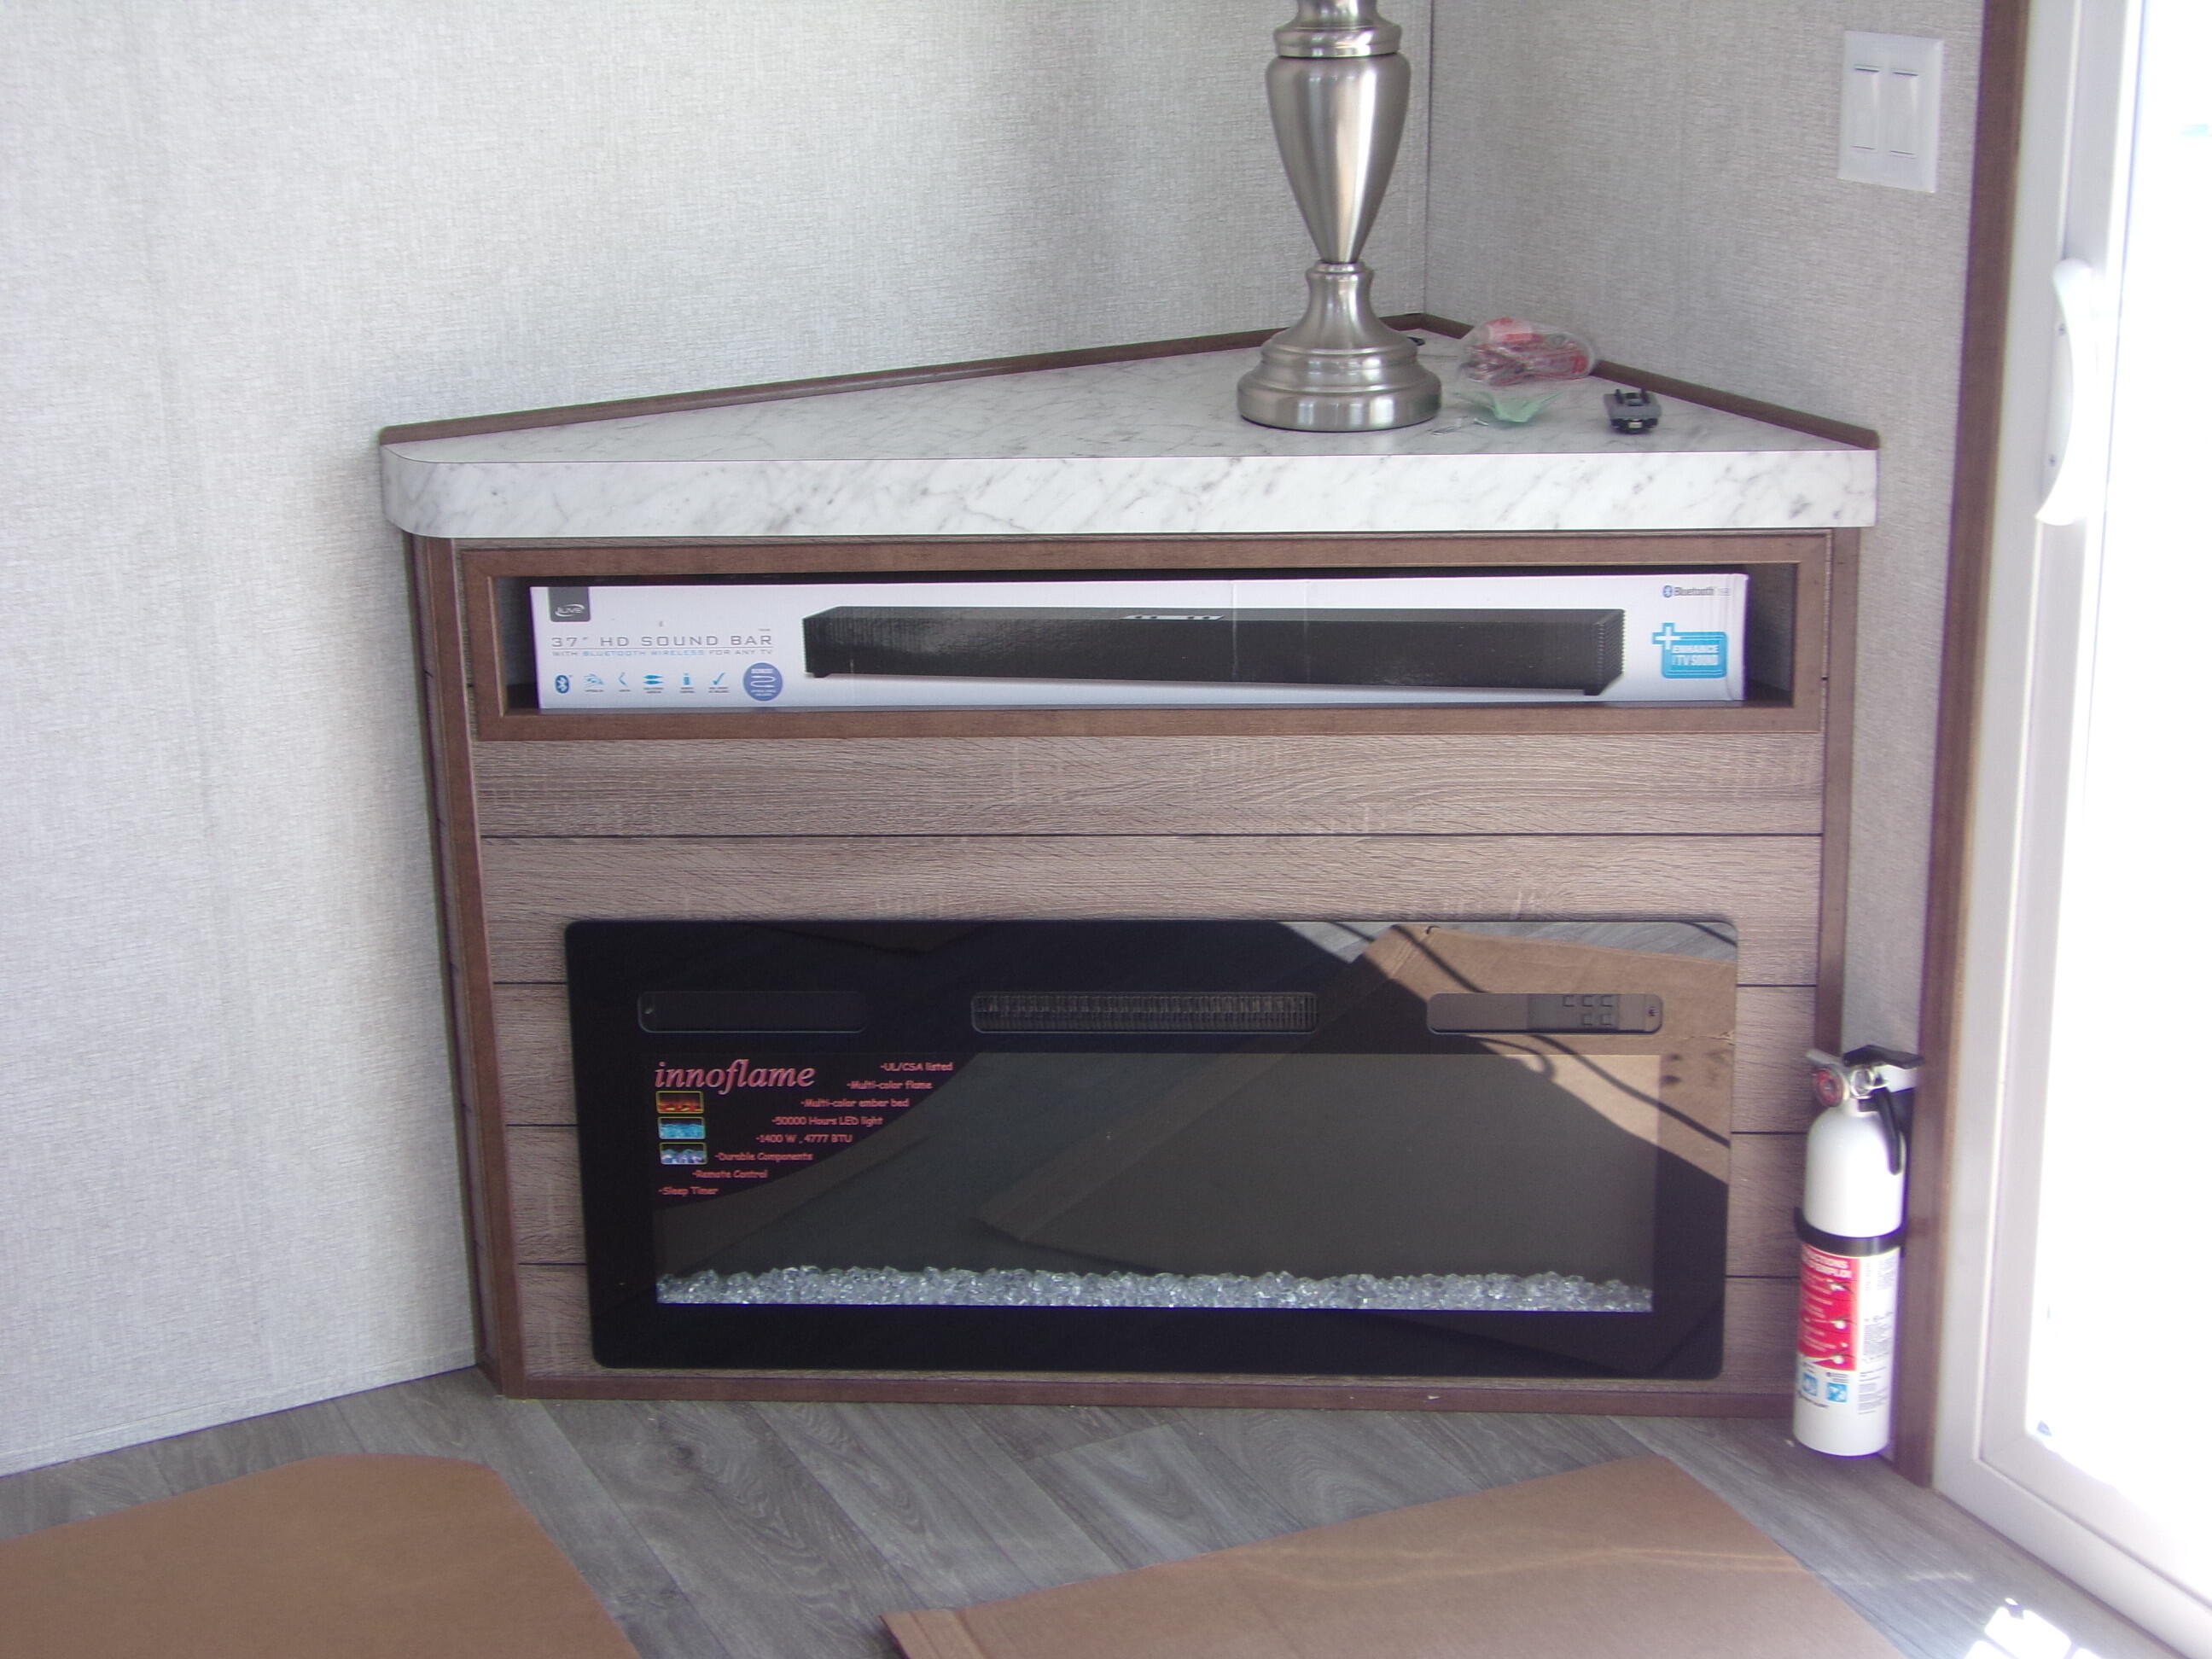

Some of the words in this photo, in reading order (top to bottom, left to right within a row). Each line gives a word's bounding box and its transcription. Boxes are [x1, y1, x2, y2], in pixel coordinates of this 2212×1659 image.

[600, 637, 630, 647] HD
[641, 636, 719, 647] SOUND
[731, 635, 772, 645] BAR
[925, 1062, 954, 1071] listed
[655, 1059, 816, 1095] innoflame
[890, 1097, 911, 1108] bed
[808, 1116, 837, 1126] Hours
[838, 1115, 859, 1126] LED
[860, 1116, 884, 1127] light
[784, 1134, 798, 1144] W
[830, 1134, 853, 1144] BTU
[757, 1152, 813, 1163] Components
[732, 1169, 768, 1179] Control
[690, 1186, 719, 1195] Timer
